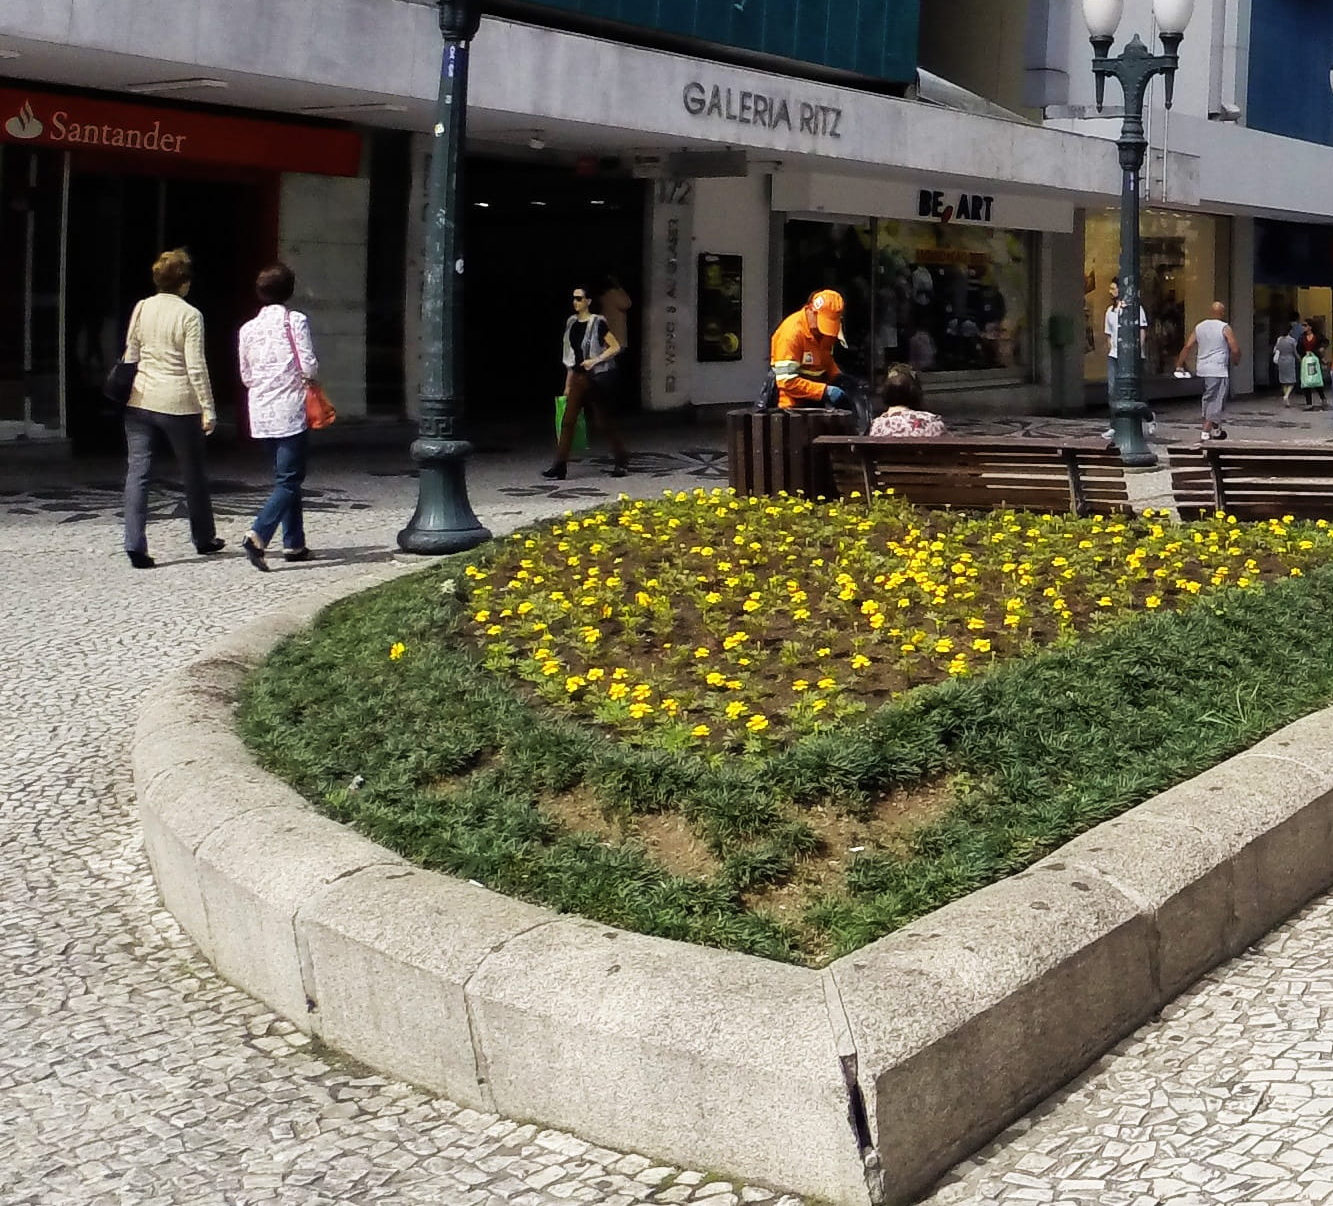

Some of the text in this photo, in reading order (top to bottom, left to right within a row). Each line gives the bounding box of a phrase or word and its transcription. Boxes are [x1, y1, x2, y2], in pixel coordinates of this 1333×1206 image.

[683, 81, 844, 138] GALERIA RITZ
[49, 110, 188, 154] Santander
[918, 189, 994, 222] BE ART
